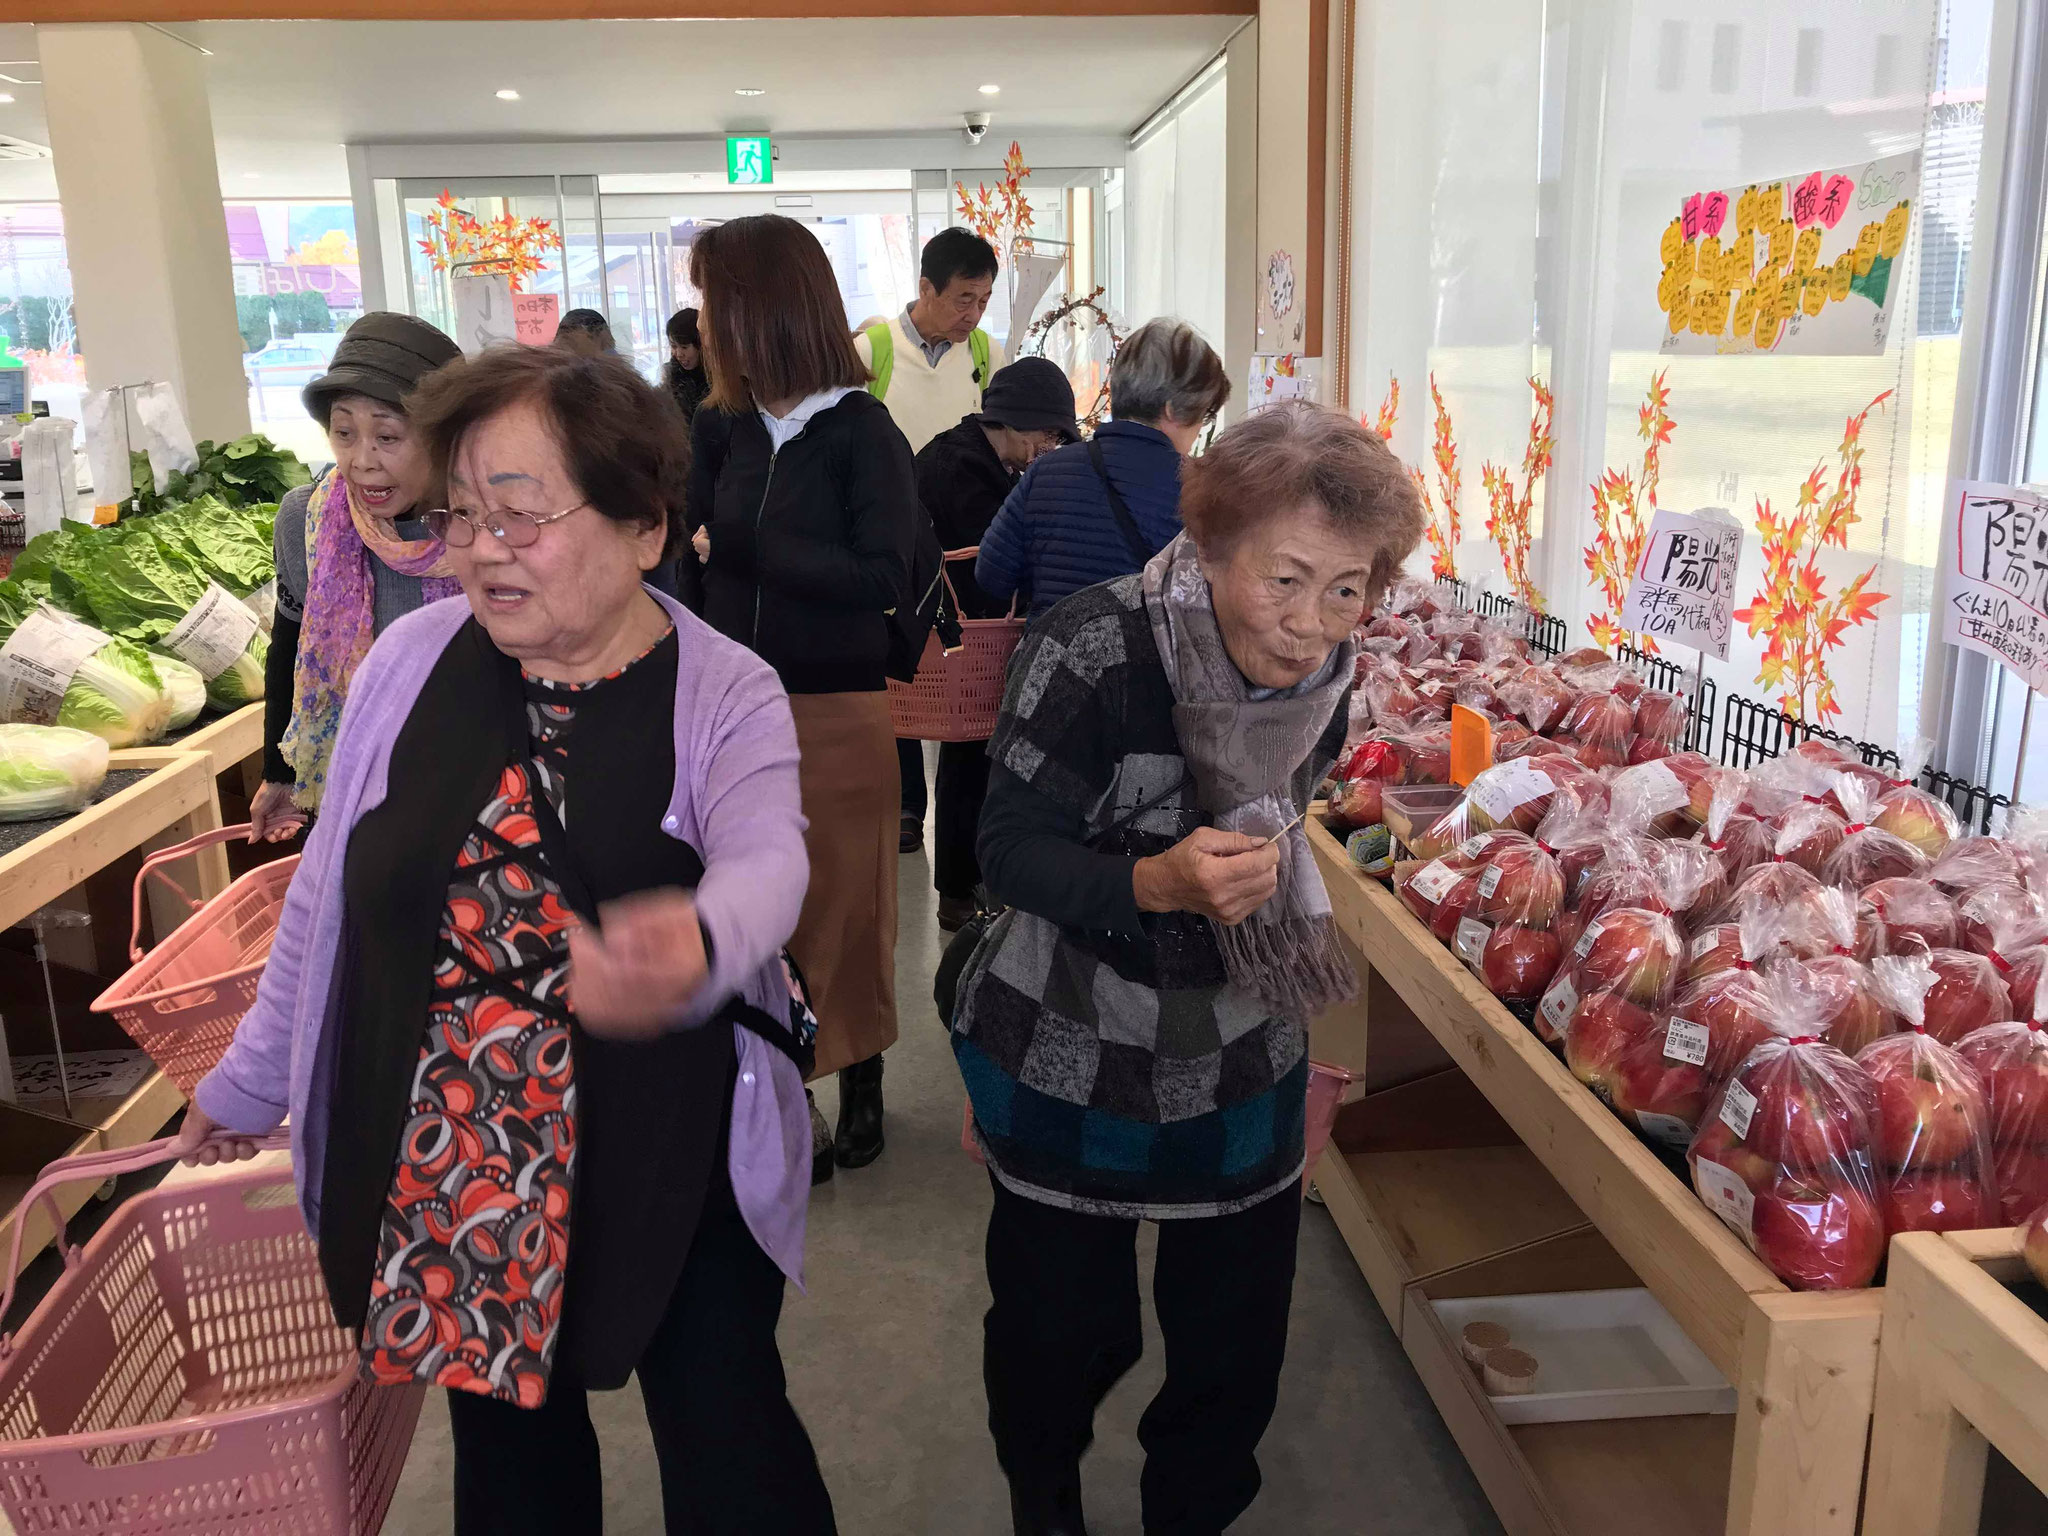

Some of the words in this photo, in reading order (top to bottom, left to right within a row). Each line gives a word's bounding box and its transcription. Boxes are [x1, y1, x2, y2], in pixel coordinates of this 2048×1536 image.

[1662, 534, 1719, 595] 陽光
[1638, 585, 1683, 616] 群馬
[1641, 613, 1677, 635] 10月
